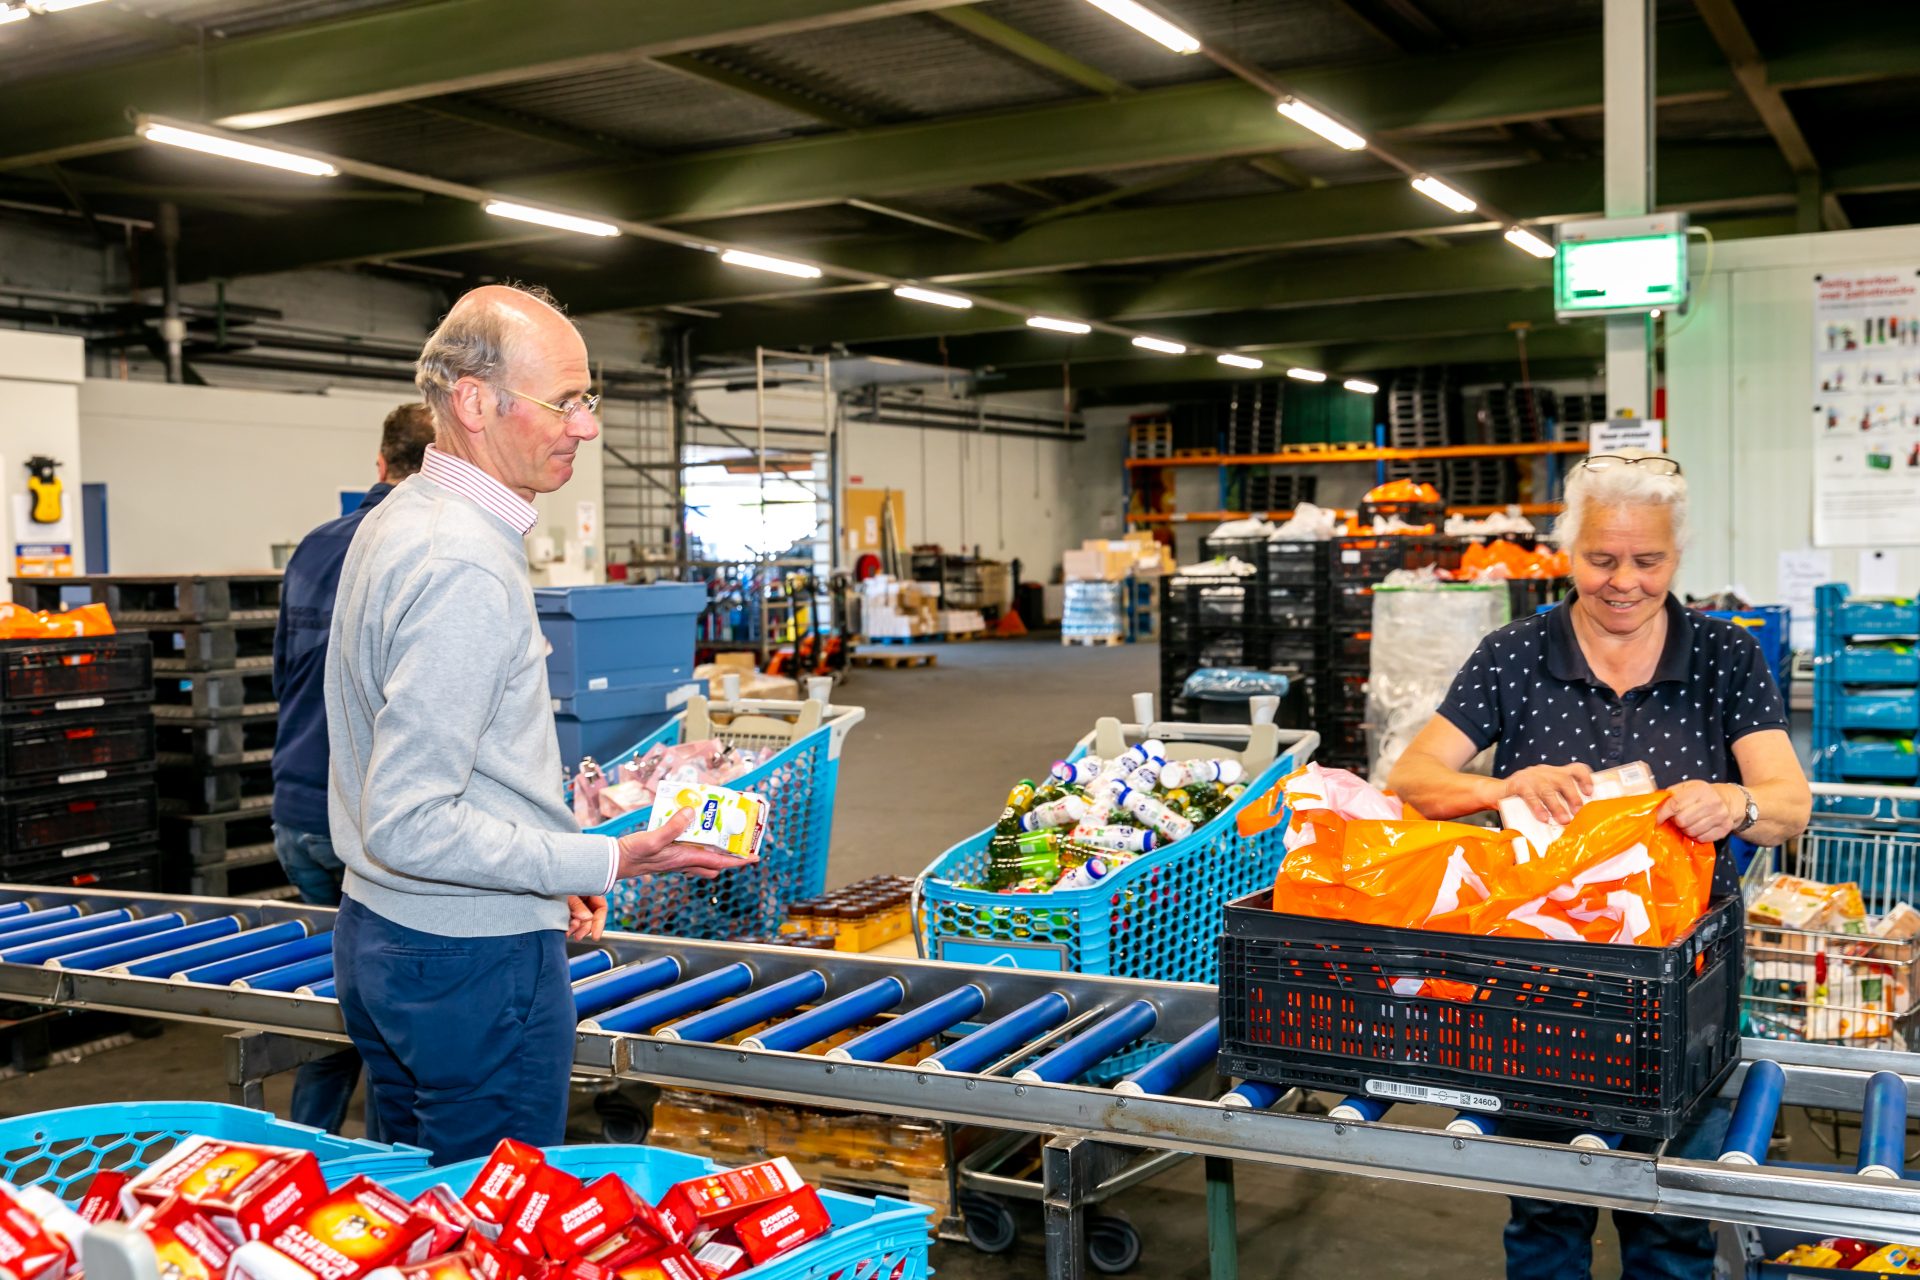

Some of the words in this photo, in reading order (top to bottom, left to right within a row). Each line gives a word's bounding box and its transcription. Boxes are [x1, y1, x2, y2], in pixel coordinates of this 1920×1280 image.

[704, 802, 716, 829] alpro
[1473, 1097, 1497, 1107] 24604
[523, 1193, 550, 1234] EGBERTS
[562, 1204, 604, 1233] EGBERTS
[761, 1212, 800, 1238] EGBERTS
[283, 1224, 360, 1276] EGBERTS
